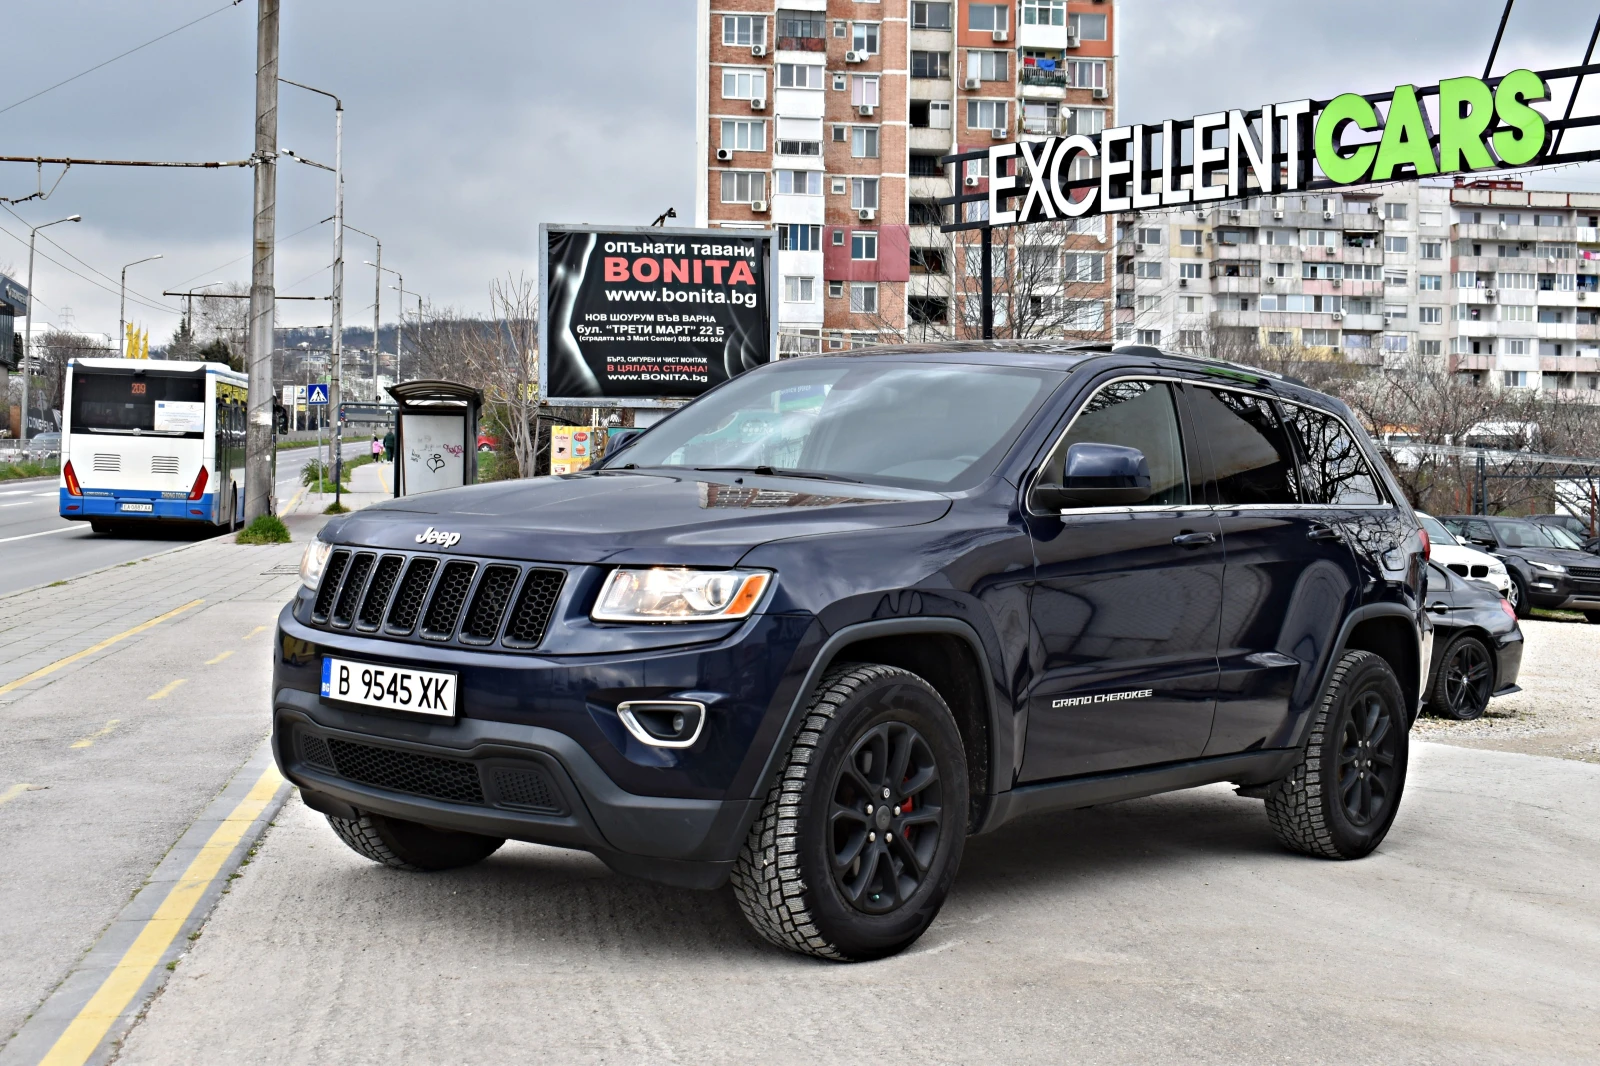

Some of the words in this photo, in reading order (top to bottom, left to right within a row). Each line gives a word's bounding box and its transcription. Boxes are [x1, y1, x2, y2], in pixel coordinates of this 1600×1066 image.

[988, 99, 1310, 226] EXCELLENT
[1314, 68, 1552, 185] CARS
[604, 241, 686, 255] опънати
[691, 244, 755, 257] тавани
[605, 288, 757, 308] www.bonita.bg
[585, 313, 608, 322] НОВ
[610, 314, 655, 322] ШОУРУМ
[683, 315, 716, 323] ВАРНА
[577, 325, 603, 335] бул.
[700, 327, 713, 335] 22
[716, 327, 725, 336] Б
[617, 365, 658, 373] ЦЯЛАТА
[663, 365, 708, 373] СТРАНА!
[608, 373, 708, 383] www.BONITA.bg
[131, 383, 146, 394] 209
[415, 526, 461, 549] Jeep
[321, 682, 331, 693] BG
[361, 669, 412, 705] 9545
[417, 676, 449, 711] XK
[1052, 696, 1092, 708] GRAND
[1094, 689, 1153, 703] CHEROKEE
